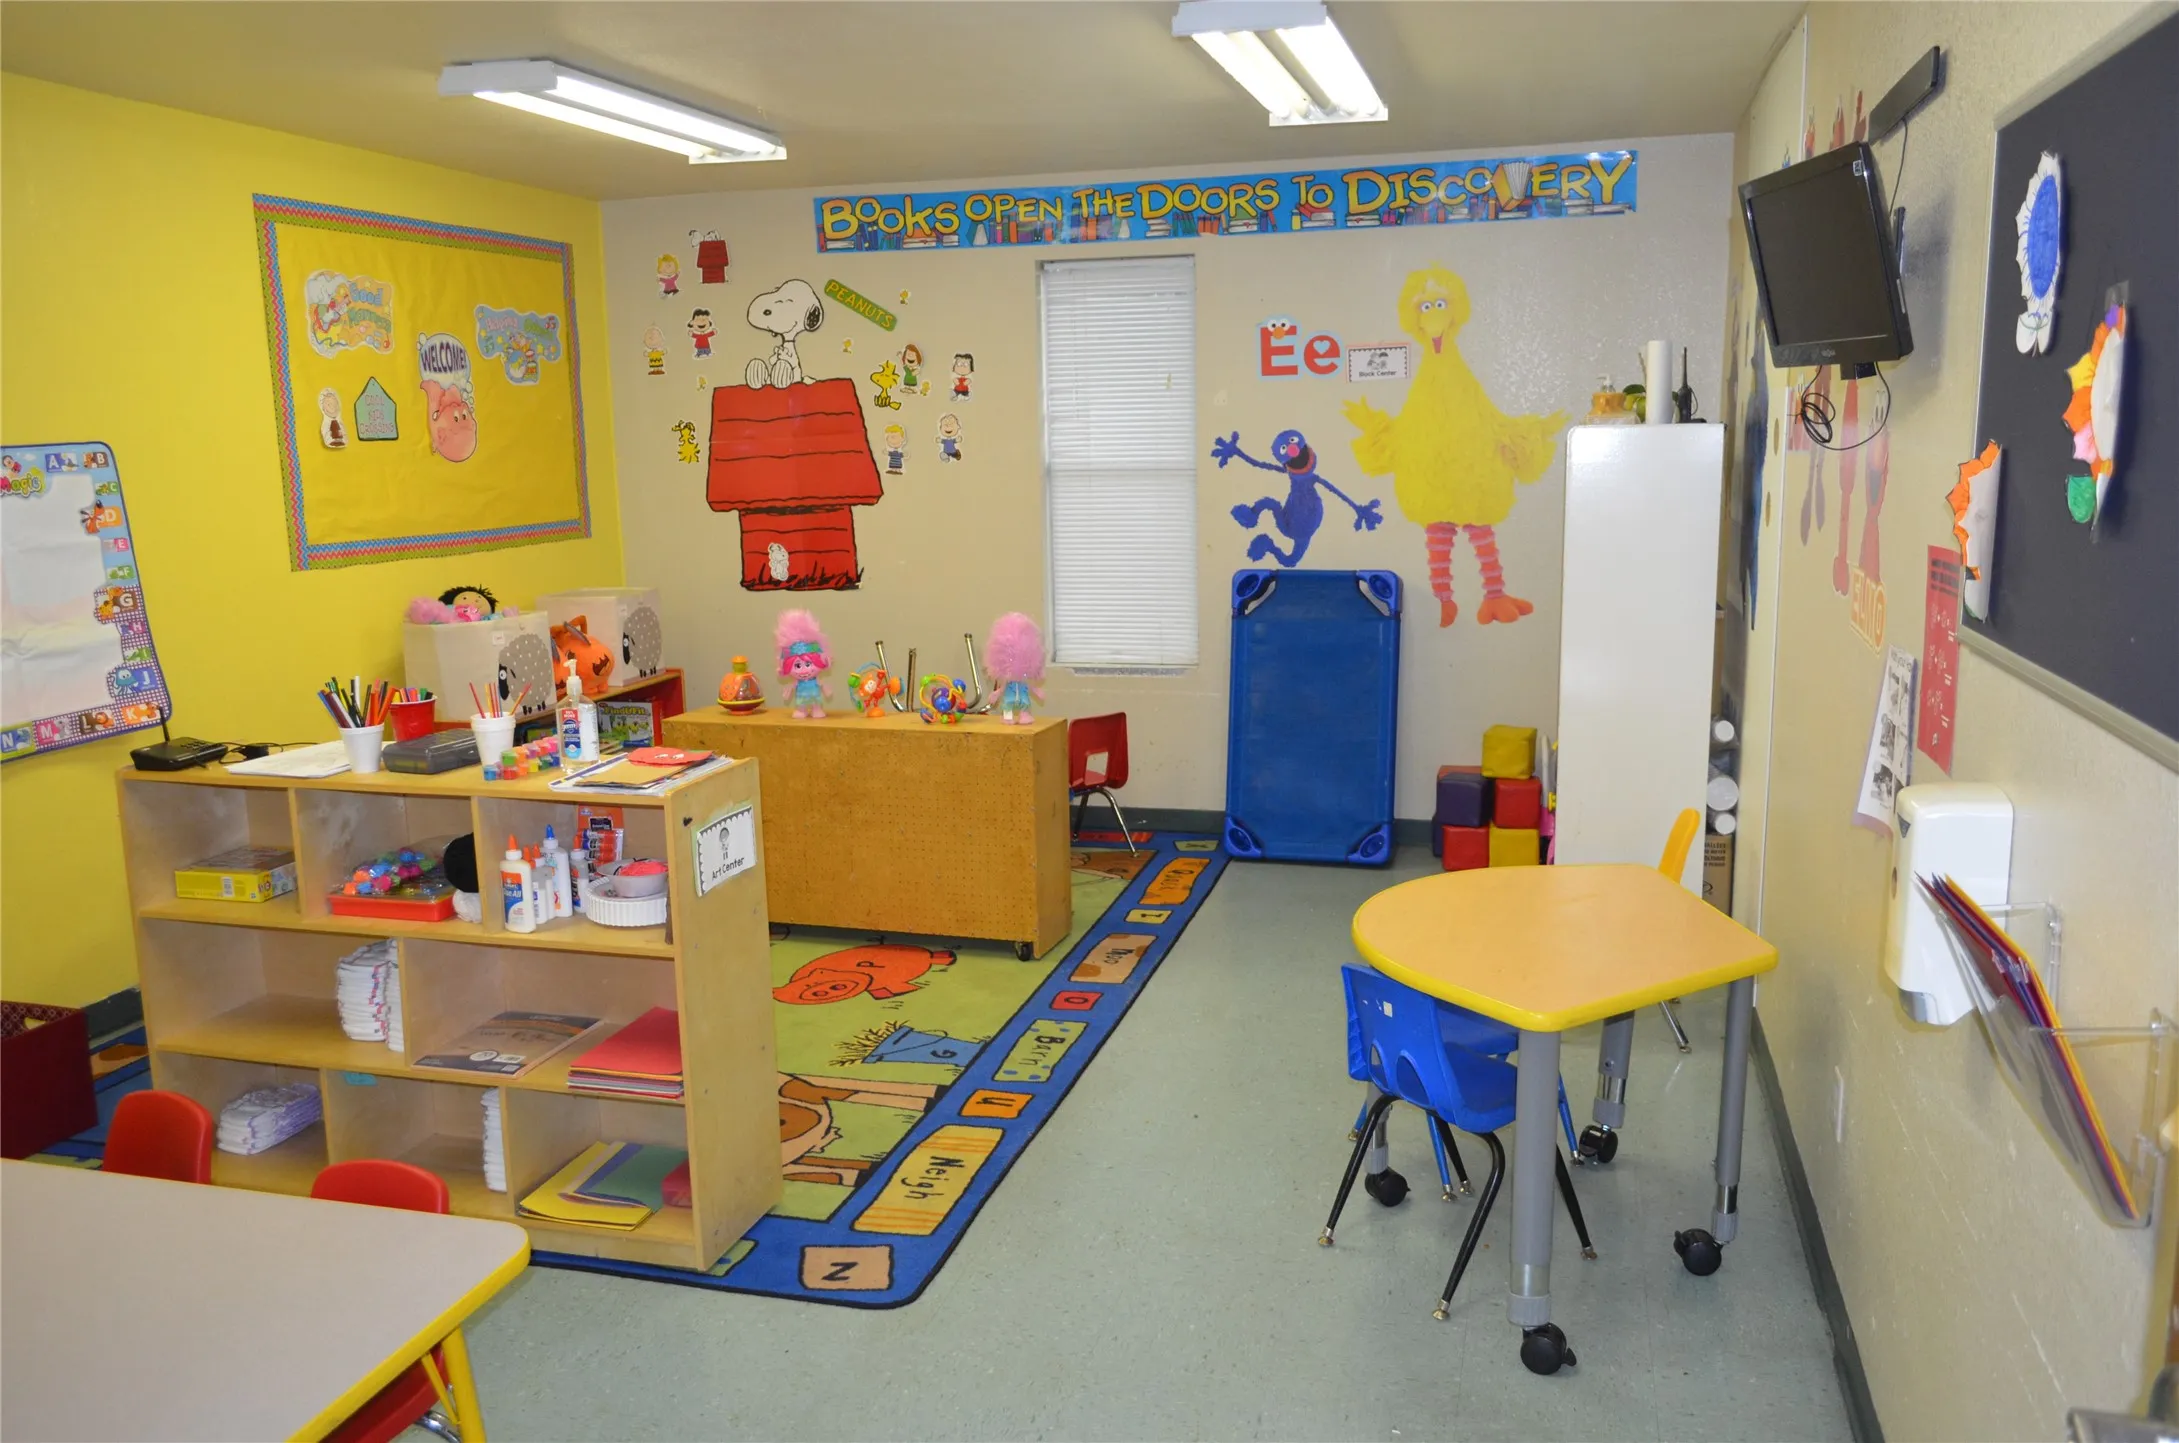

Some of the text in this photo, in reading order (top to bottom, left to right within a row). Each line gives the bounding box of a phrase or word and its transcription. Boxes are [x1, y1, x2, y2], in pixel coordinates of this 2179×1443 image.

[822, 153, 1634, 240] BOOKS OPEN THE DOORS TO DISCOVERY
[825, 281, 894, 330] PEANUTS
[421, 342, 467, 373] WELCOME!
[1260, 325, 1341, 377] Ee
[1358, 369, 1398, 378] Block Center
[48, 455, 60, 469] A
[96, 453, 105, 464] B
[109, 482, 117, 492] C
[105, 508, 117, 522] D
[118, 538, 127, 549] E
[123, 566, 131, 577] F
[119, 592, 134, 607] G
[132, 621, 143, 632] H
[142, 670, 151, 685] J
[81, 707, 138, 729] L K
[2, 725, 53, 748] N M
[712, 857, 745, 880] Art Center
[1104, 947, 1136, 966] Moo
[930, 1049, 958, 1059] G
[1018, 1035, 1067, 1068] Barn
[900, 1155, 966, 1200] Neigh
